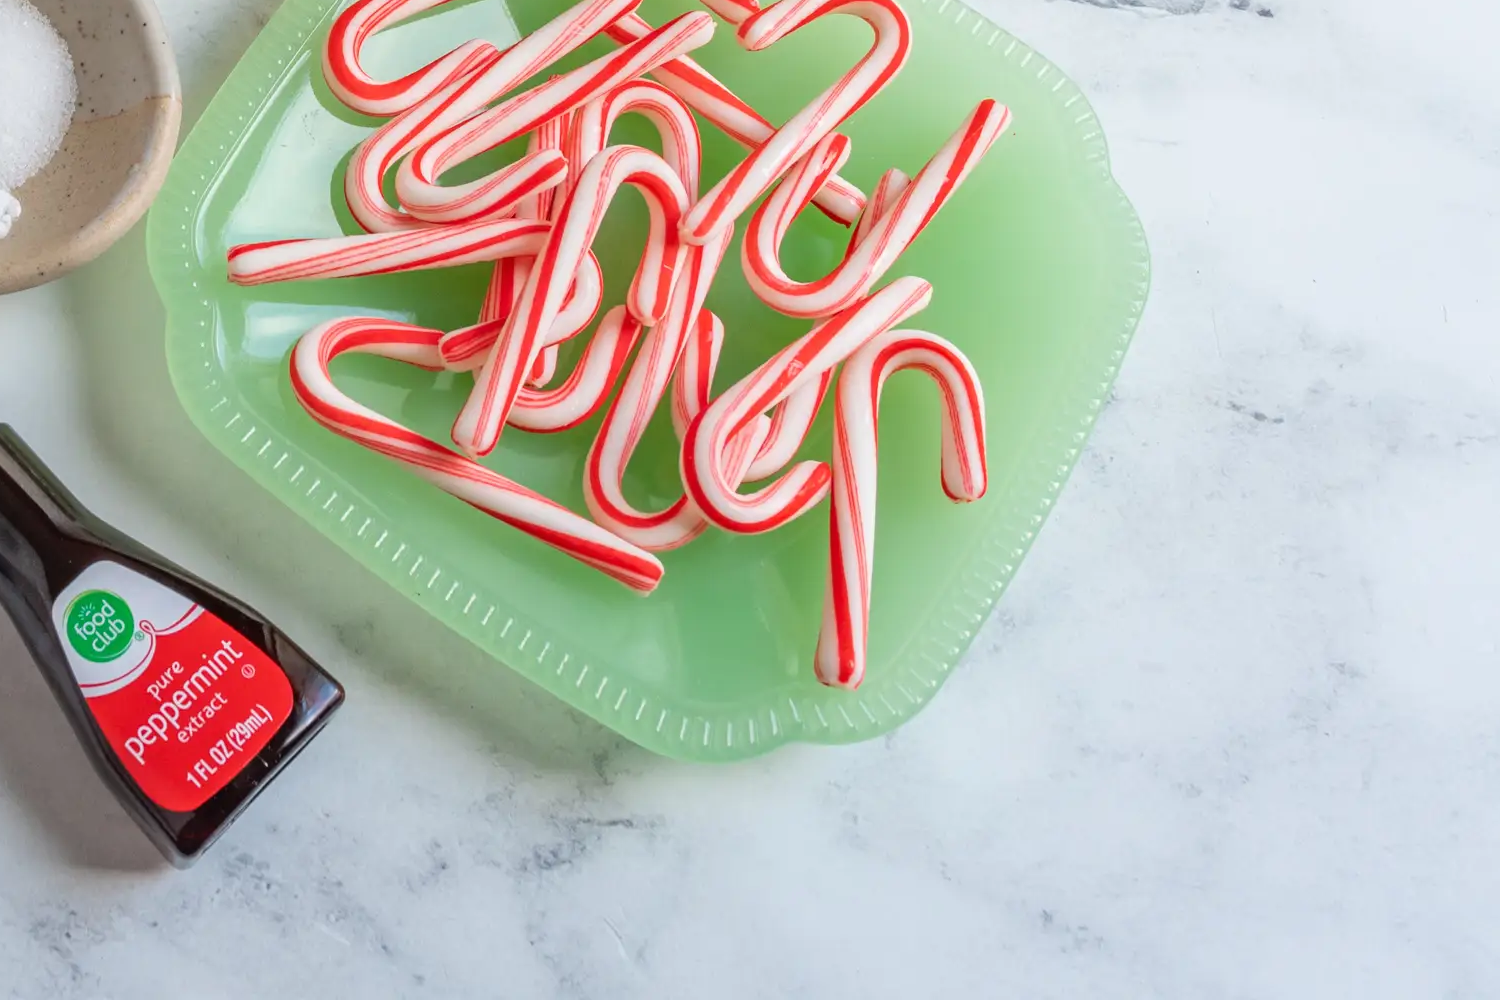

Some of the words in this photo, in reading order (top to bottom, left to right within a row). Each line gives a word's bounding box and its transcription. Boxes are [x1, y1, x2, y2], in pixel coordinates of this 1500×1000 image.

[74, 599, 116, 640] food
[92, 619, 126, 652] club
[124, 638, 244, 766] peppermint
[177, 692, 228, 744] extract
[226, 703, 274, 752] (29mL)
[193, 755, 218, 782] FL
[209, 738, 234, 765] OZ
[186, 770, 201, 789] 1
